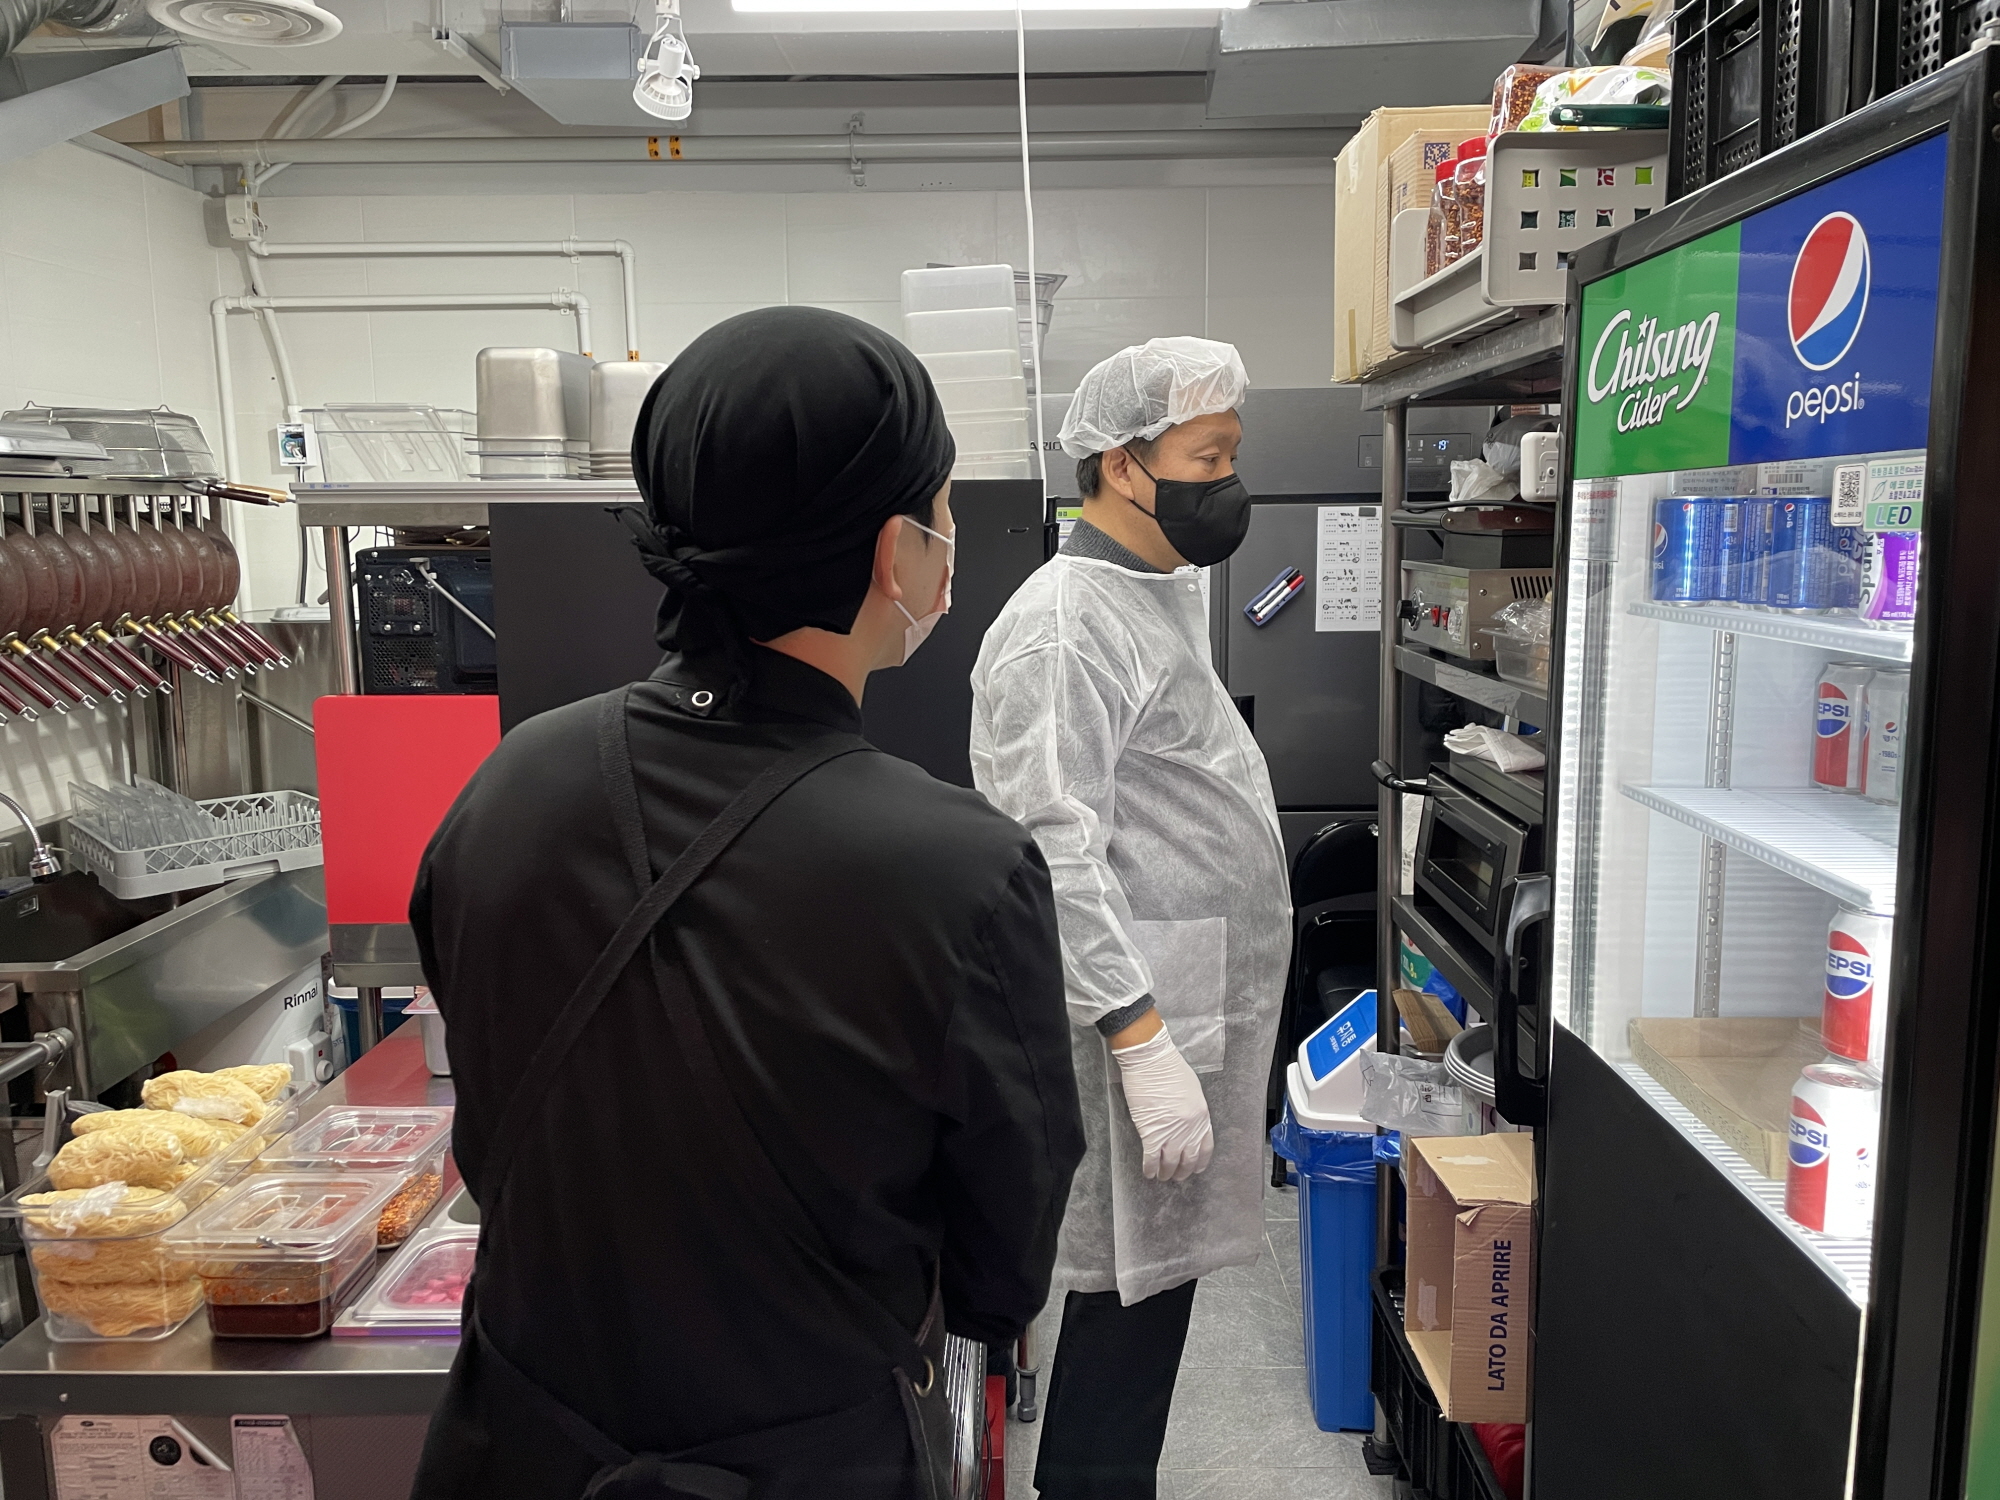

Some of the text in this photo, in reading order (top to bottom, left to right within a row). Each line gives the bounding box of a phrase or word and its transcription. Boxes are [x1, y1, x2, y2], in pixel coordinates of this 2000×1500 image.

[1587, 309, 1720, 410] Chilsung
[1617, 385, 1680, 433] Cider
[1785, 371, 1860, 429] pepsi
[1875, 505, 1912, 526] LED
[1838, 528, 1853, 577] peps
[1858, 534, 1876, 605] Spark
[1818, 702, 1849, 717] EPSI
[1827, 952, 1871, 977] EPSI
[284, 982, 318, 1010] Rinnai
[1790, 1119, 1828, 1148] EPSI
[1488, 1240, 1512, 1391] LATO DA APRIRE
